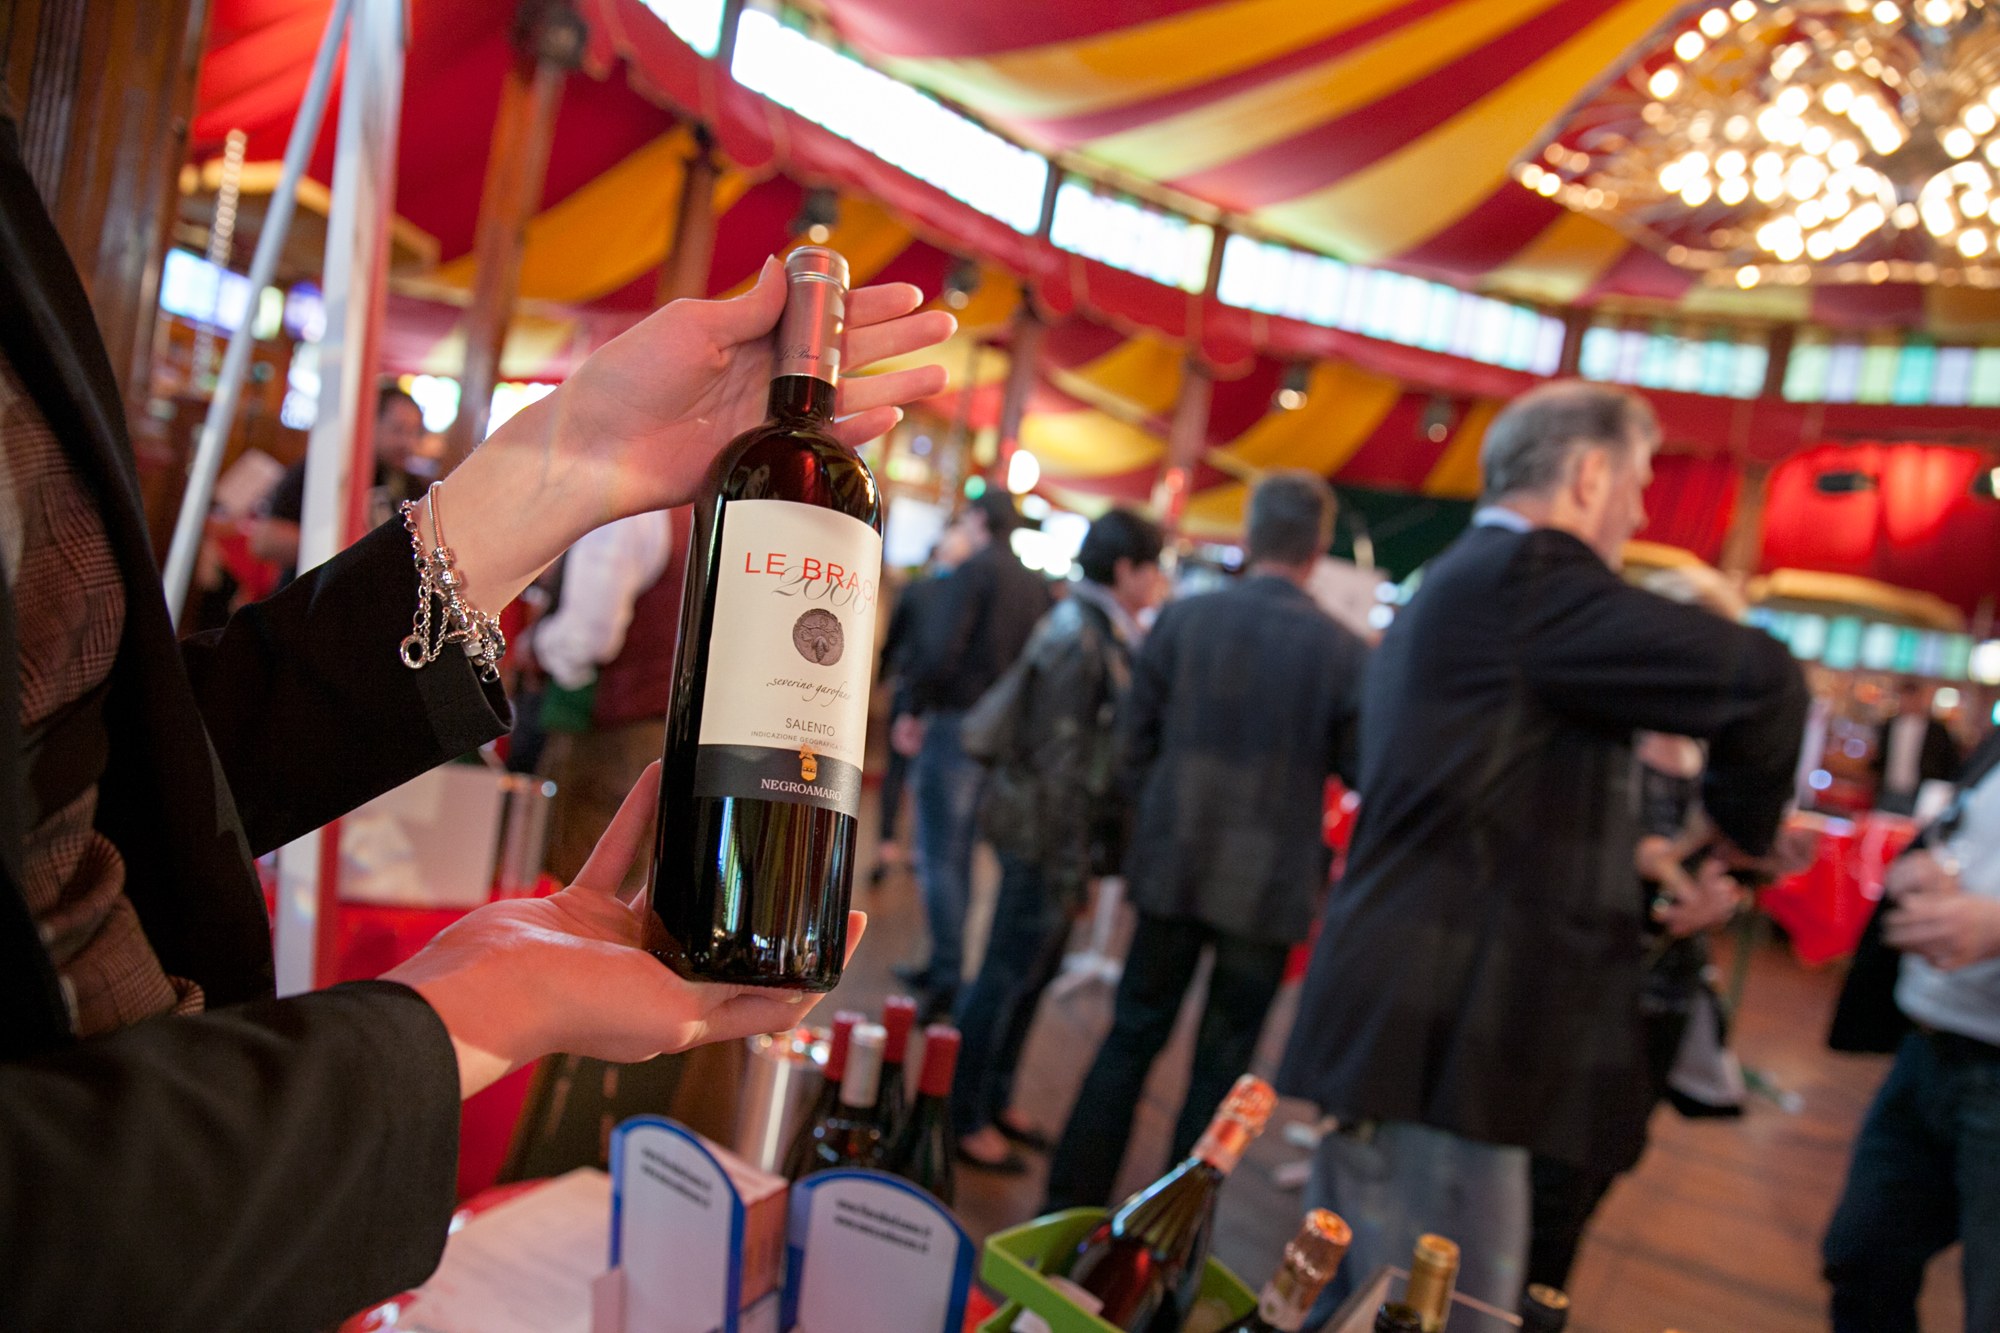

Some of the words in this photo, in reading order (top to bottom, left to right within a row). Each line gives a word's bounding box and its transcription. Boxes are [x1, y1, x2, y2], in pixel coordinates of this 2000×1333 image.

[745, 552, 787, 576] LE
[766, 678, 814, 690] severino
[785, 718, 835, 737] SALENTO
[751, 731, 798, 742] INDICAZIONE
[799, 737, 839, 750] GEOGRAFICA
[761, 779, 842, 801] NEGROAMARO
